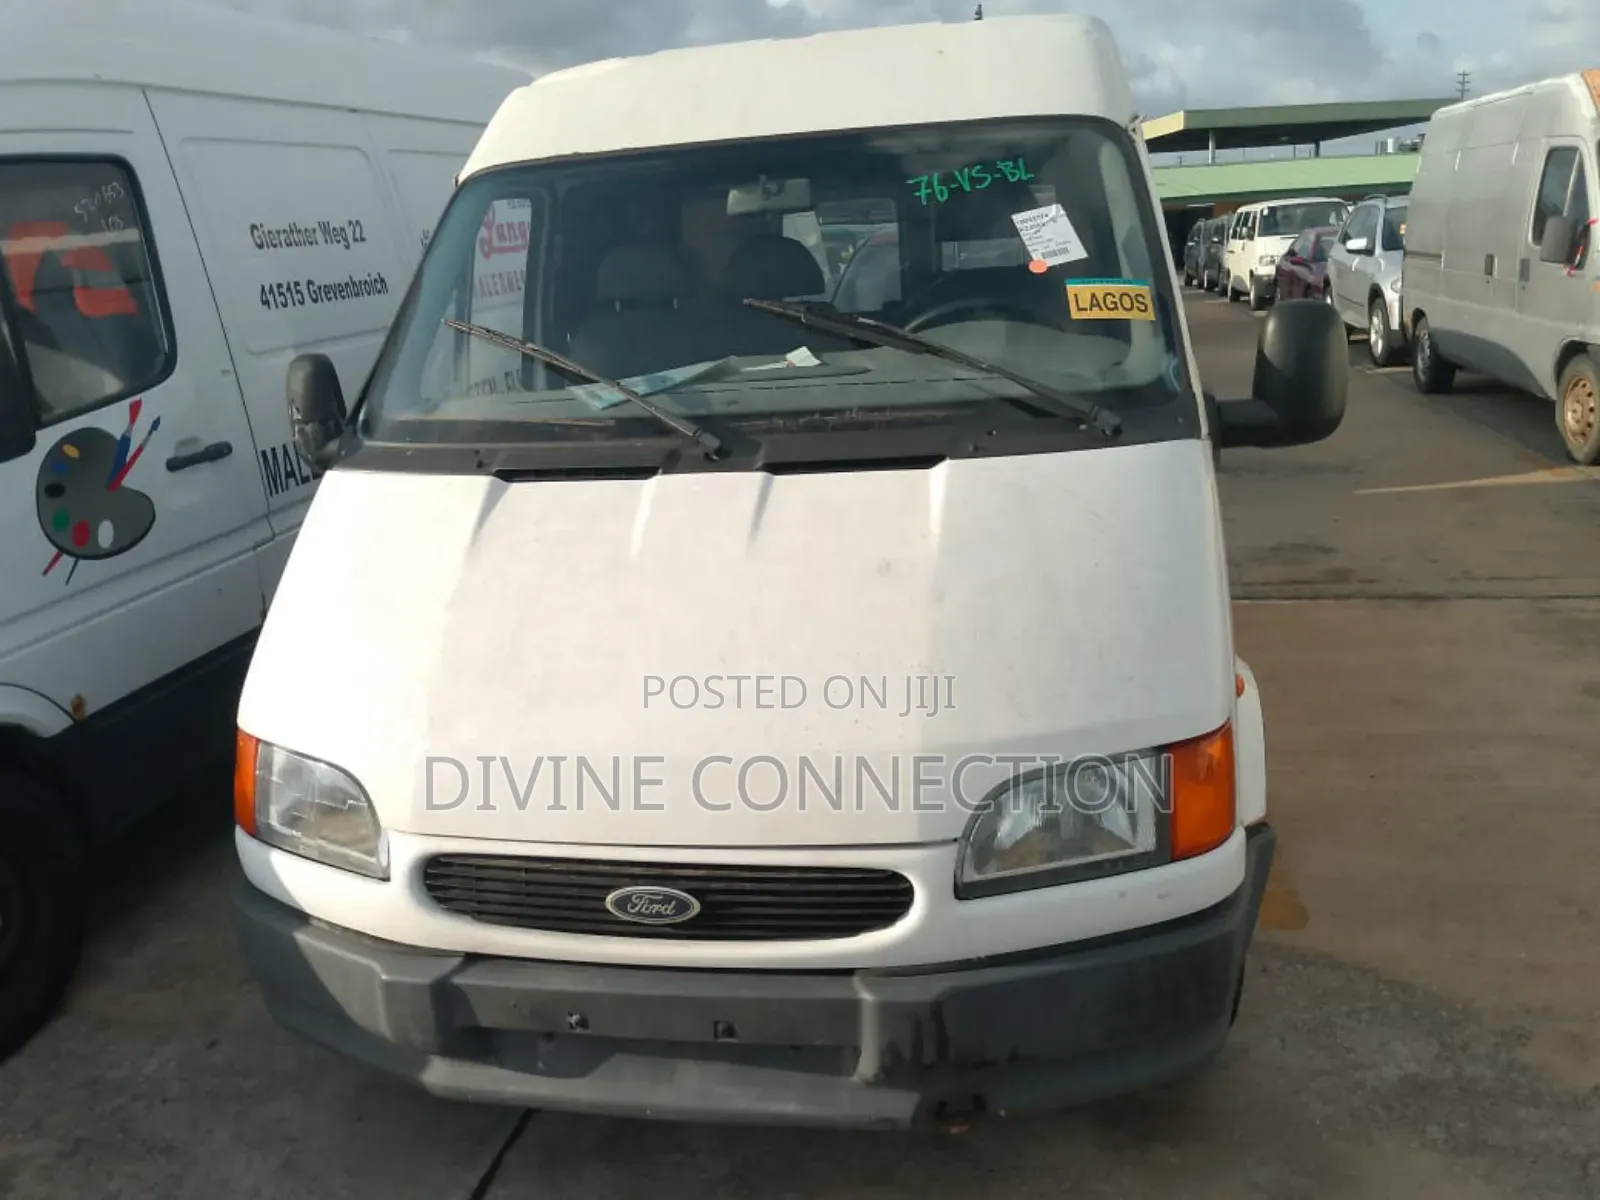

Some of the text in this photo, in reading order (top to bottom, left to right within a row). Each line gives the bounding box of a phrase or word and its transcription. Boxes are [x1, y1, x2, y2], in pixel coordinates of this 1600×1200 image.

[906, 157, 1034, 205] 76-VS-BL
[250, 219, 367, 251] Gierather Weg 22
[259, 272, 389, 310] 41515 Grevenbroich
[1073, 292, 1149, 313] LAGOS
[626, 892, 677, 915] Ford
